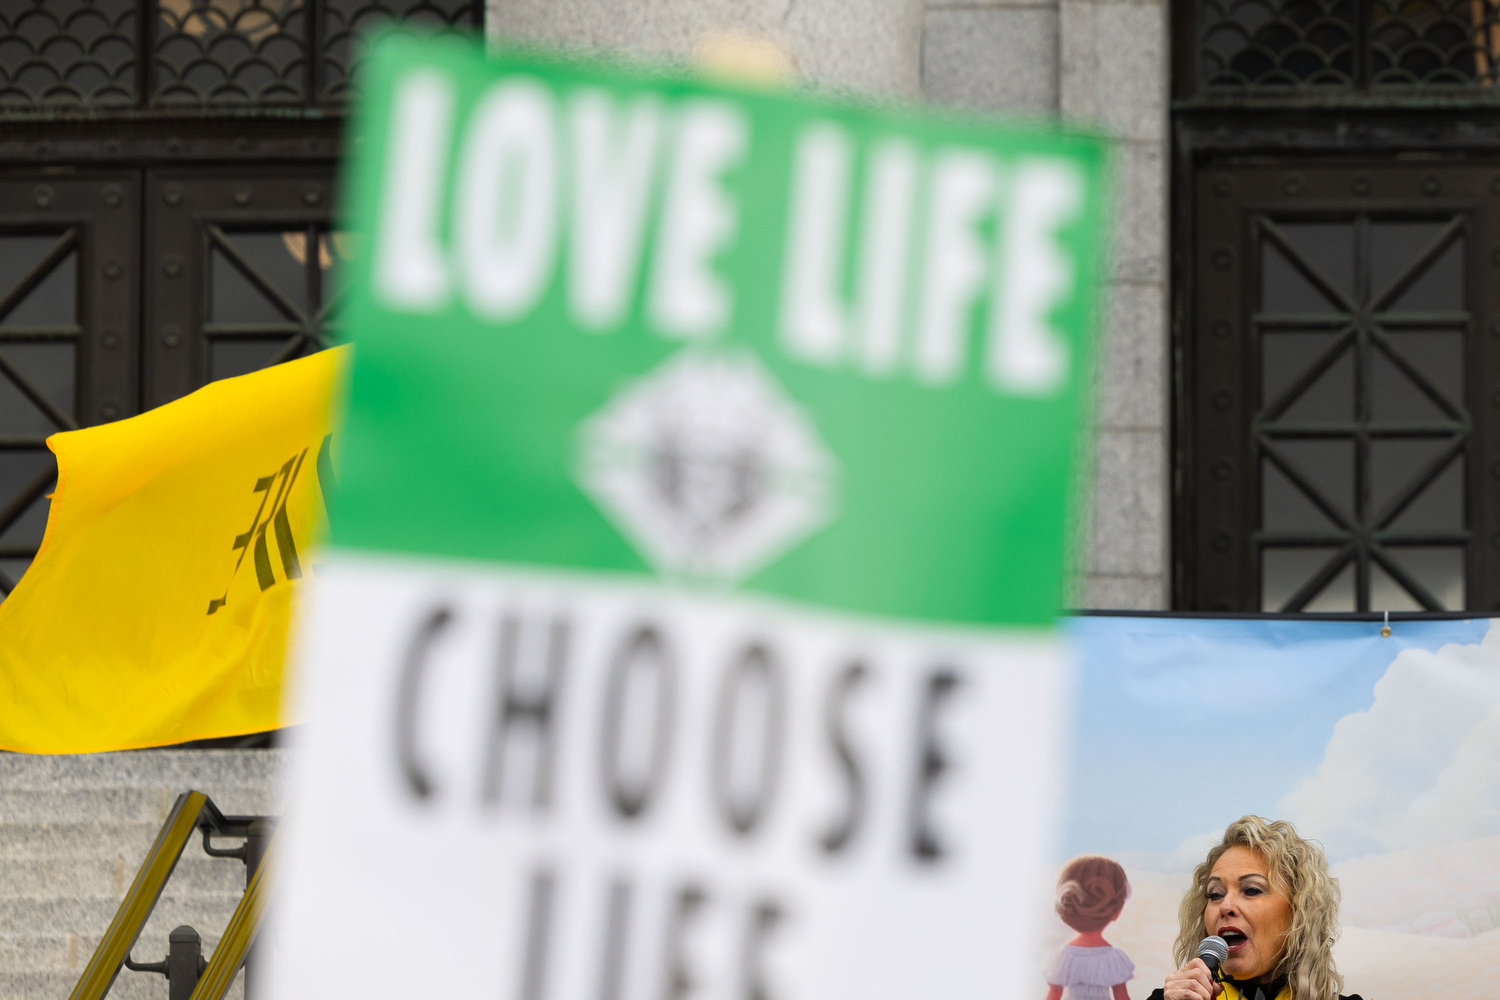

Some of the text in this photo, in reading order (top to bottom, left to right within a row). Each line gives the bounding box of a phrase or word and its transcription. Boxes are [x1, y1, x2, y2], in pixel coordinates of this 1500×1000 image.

[378, 68, 1086, 394] LOVE LIFE
[394, 602, 972, 864] CHOOSE
